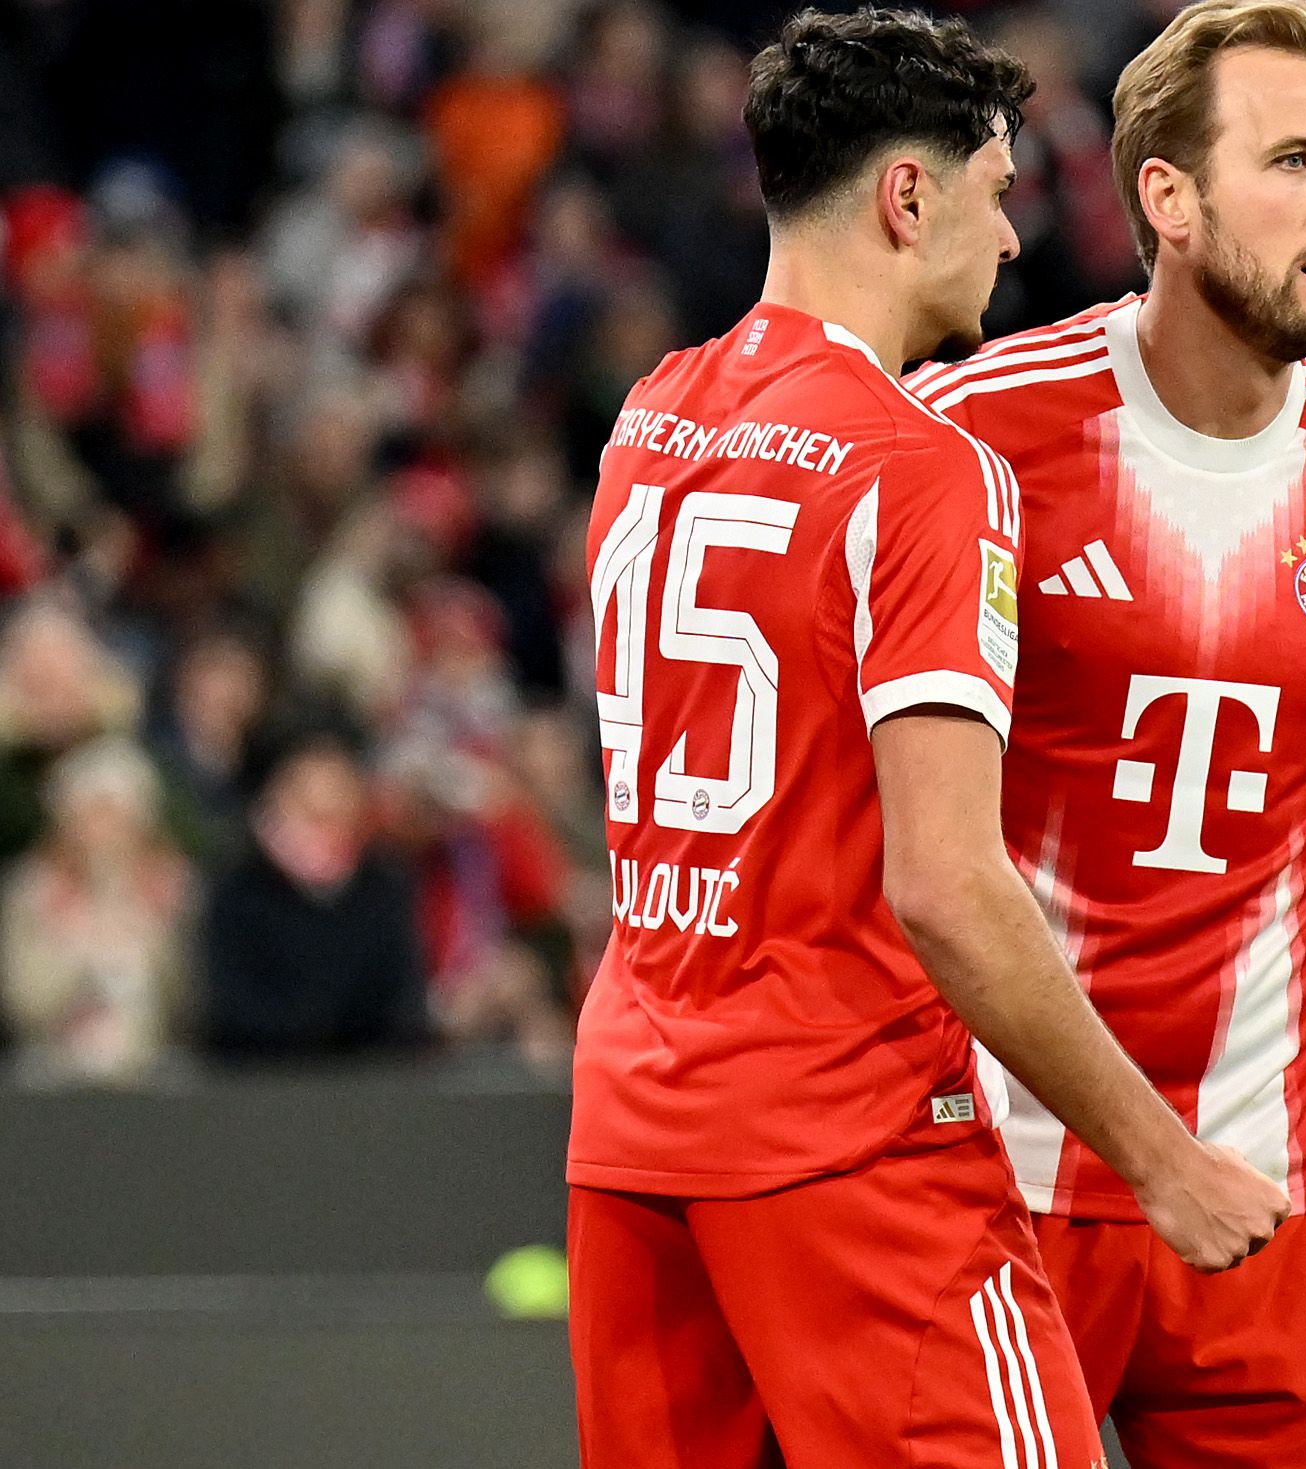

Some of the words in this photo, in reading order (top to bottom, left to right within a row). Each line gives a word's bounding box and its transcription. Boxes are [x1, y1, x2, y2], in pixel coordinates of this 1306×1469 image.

[591, 483, 801, 834] 45
[1112, 674, 1281, 875] T
[609, 849, 741, 938] VLOVIĆ
